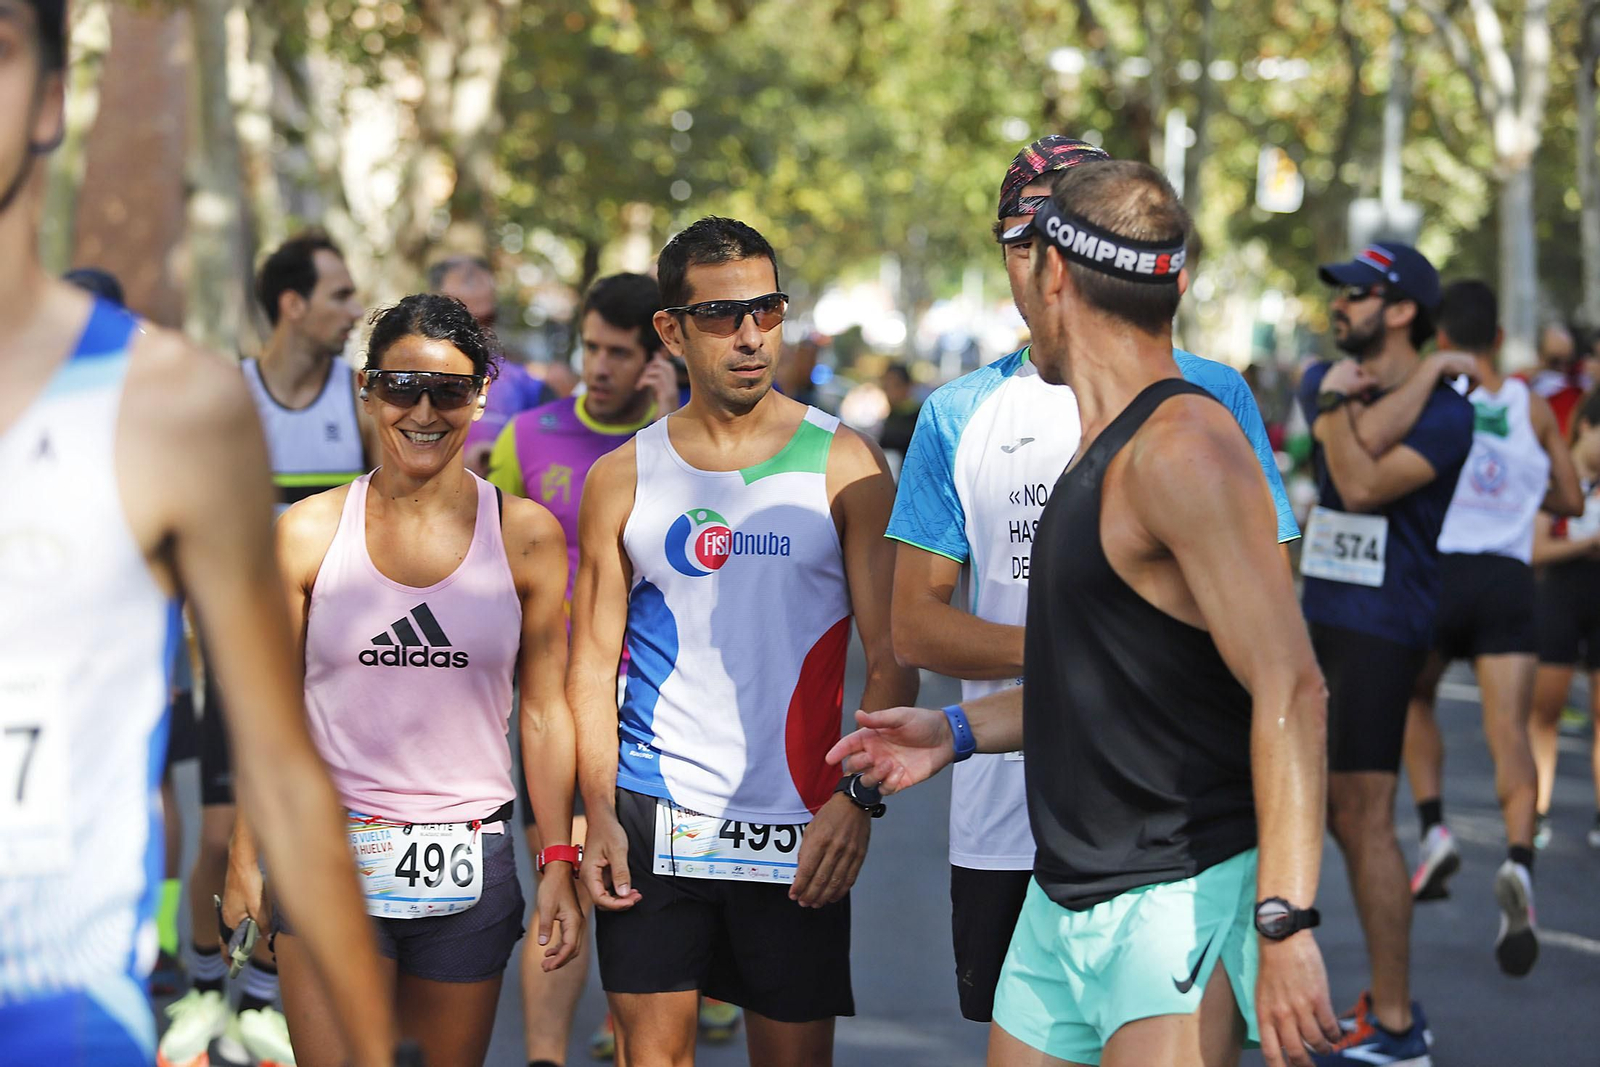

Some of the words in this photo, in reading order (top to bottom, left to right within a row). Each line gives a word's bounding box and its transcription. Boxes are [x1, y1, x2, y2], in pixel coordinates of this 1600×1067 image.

[1024, 483, 1048, 507] NO
[703, 531, 791, 557] FisiOnuba
[1334, 532, 1379, 562] 574
[358, 644, 469, 669] adidas
[359, 830, 392, 843] VUELTA
[719, 818, 797, 853] 495
[360, 842, 394, 855] HUELVA
[394, 842, 474, 888] 496
